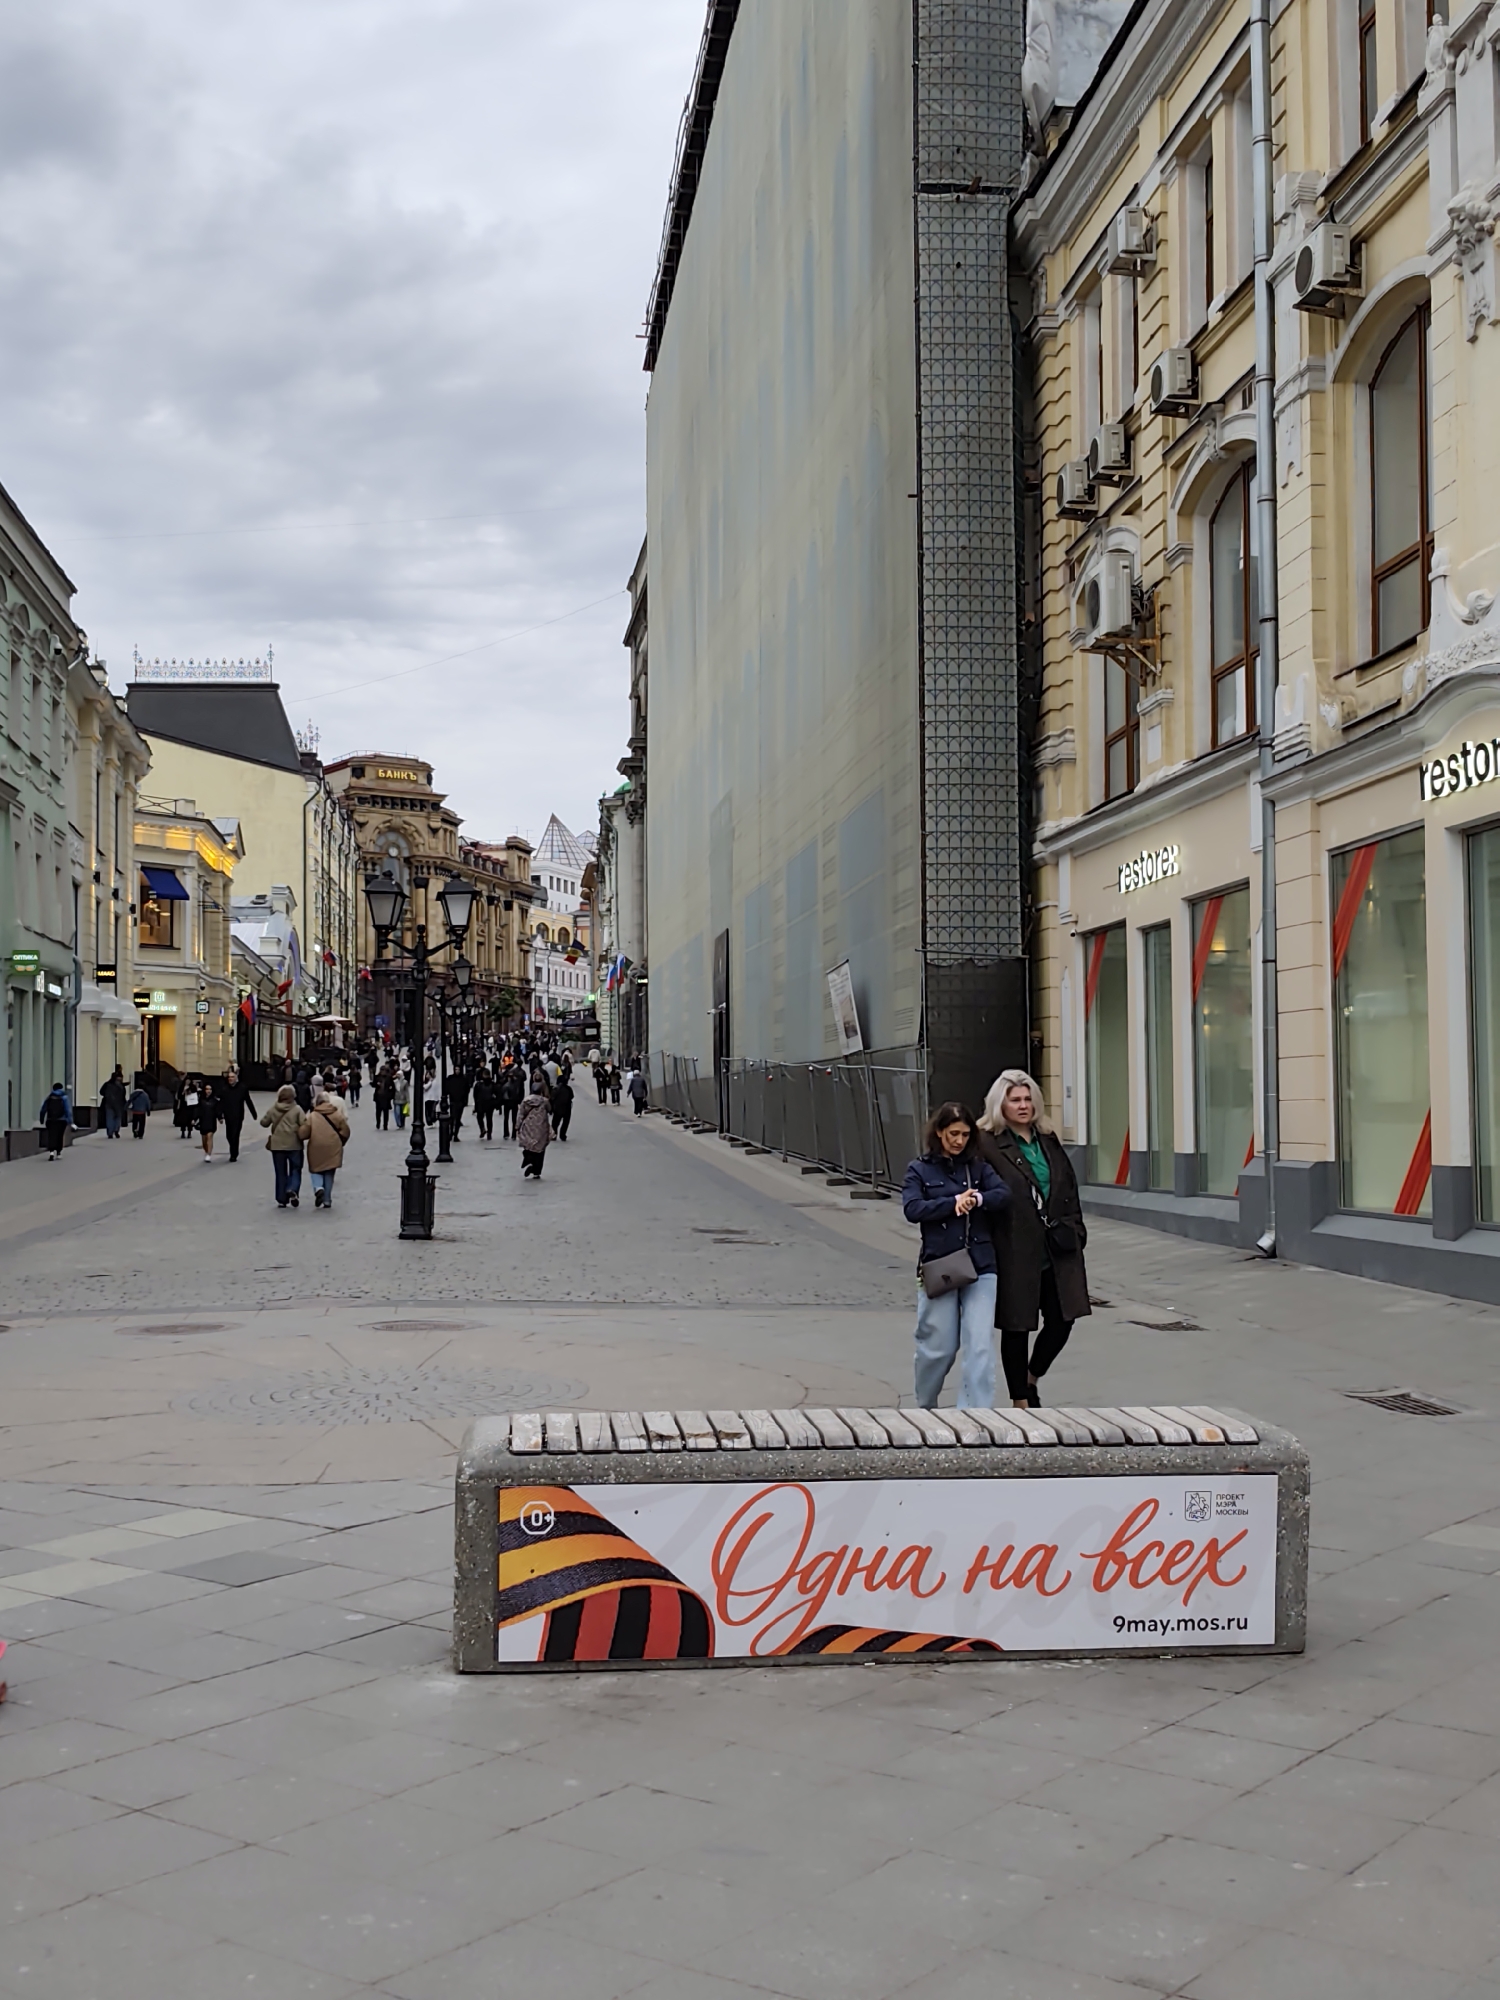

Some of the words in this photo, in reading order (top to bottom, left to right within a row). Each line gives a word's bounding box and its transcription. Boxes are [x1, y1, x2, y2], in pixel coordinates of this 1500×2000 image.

[378, 769, 417, 781] БАНКЪ
[1215, 1493, 1245, 1501] ПРОЕКТ
[1215, 1500, 1237, 1508] МЭРА
[531, 1509, 557, 1527] 0+
[1215, 1508, 1249, 1516] МОСКВЫ
[711, 1482, 947, 1657] Одна
[961, 1543, 1072, 1597] на
[1079, 1497, 1249, 1608] всех
[1112, 1614, 1249, 1636] 9may.mos.ru
